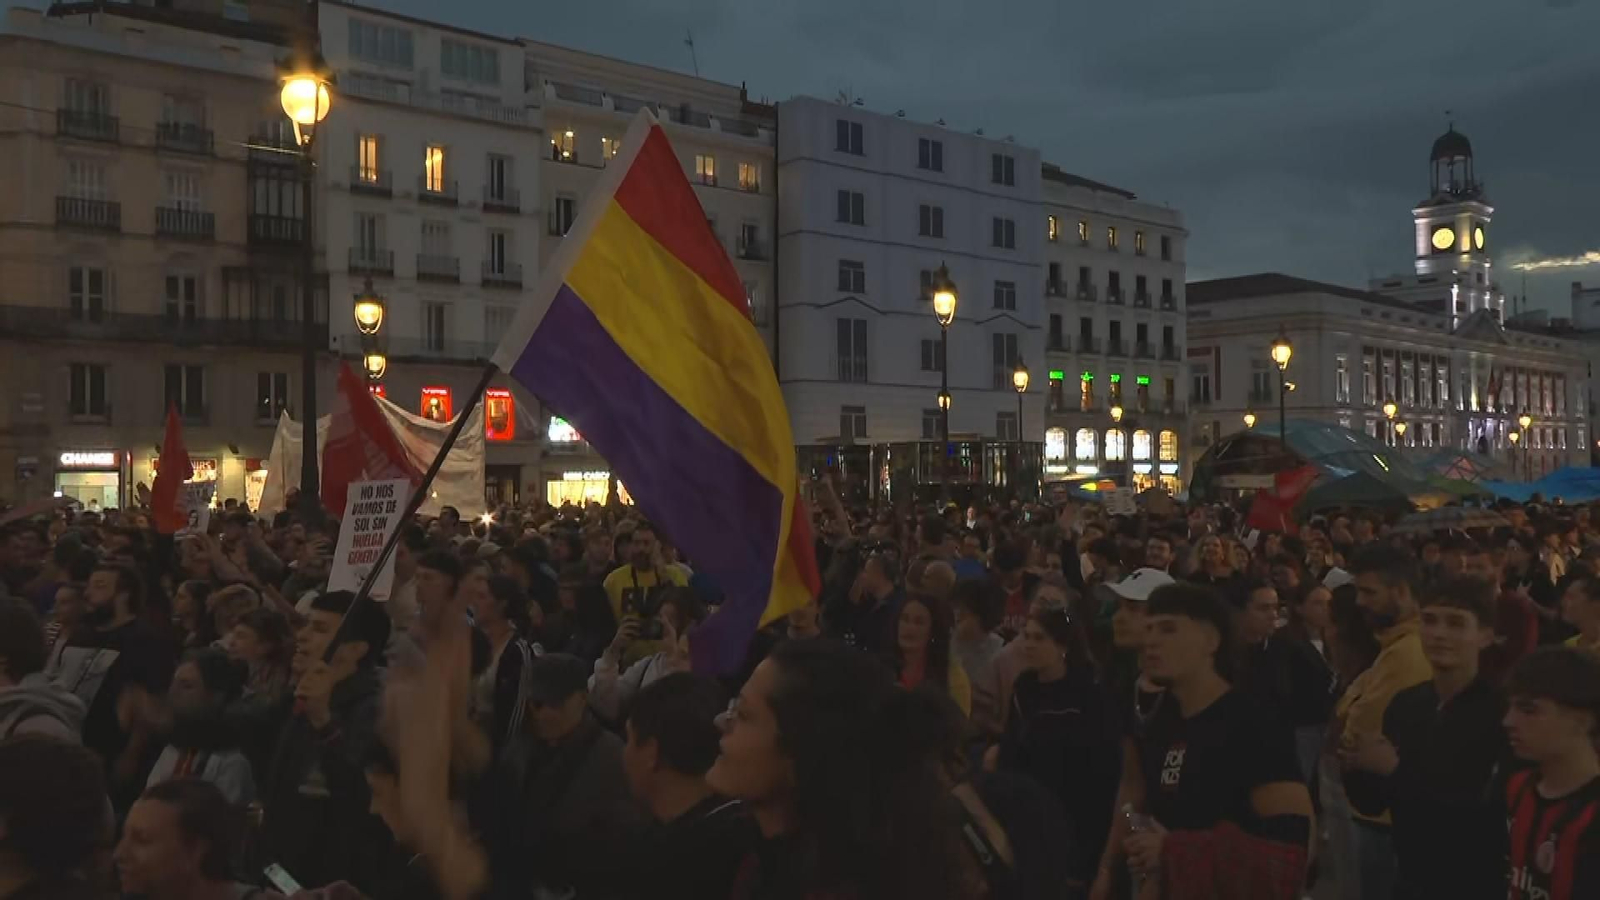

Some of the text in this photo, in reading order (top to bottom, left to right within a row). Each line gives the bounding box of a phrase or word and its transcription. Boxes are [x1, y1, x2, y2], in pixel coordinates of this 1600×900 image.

[361, 484, 394, 500] NO NOS
[352, 500, 397, 515] VAMOS DE
[354, 516, 388, 532] SOL SIN
[352, 533, 383, 548] HUELGA
[347, 548, 381, 565] GENERA
